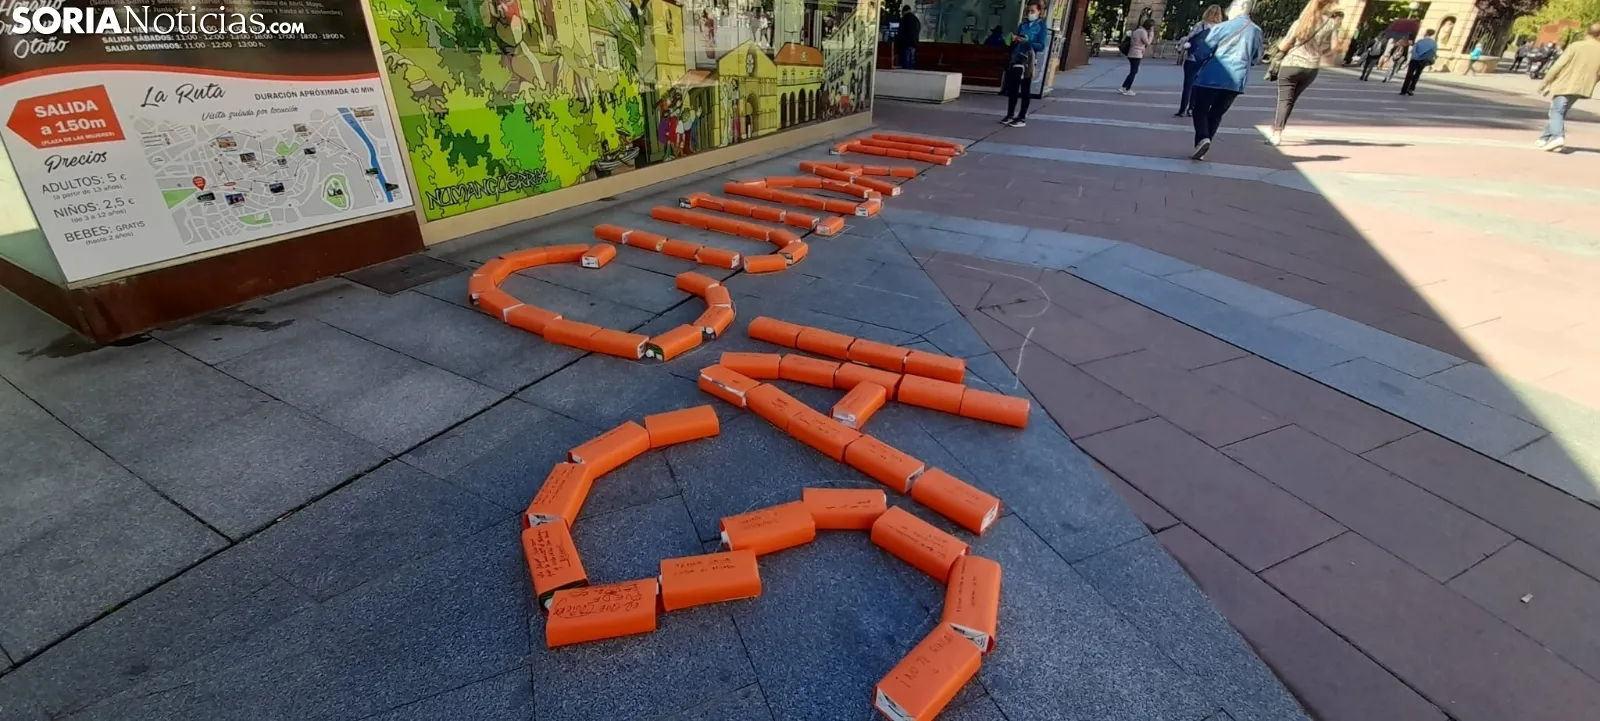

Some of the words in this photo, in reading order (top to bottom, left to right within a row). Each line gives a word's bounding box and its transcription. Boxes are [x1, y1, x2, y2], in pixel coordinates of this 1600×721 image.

[14, 36, 70, 58] Otoño
[136, 43, 183, 51] DOMINGOS:
[140, 86, 169, 107] La
[175, 82, 227, 104] Ruta
[254, 90, 298, 101] DURACIÓN
[361, 86, 375, 94] MIN
[34, 100, 99, 118] SALIDA
[201, 111, 227, 122] Visita
[228, 109, 254, 121] guiada
[255, 108, 269, 118] por
[40, 125, 52, 136] a
[55, 118, 107, 133] 150m
[44, 149, 108, 173] Precios
[42, 175, 105, 194] ADULTOS:
[106, 172, 117, 183] 5
[120, 173, 127, 181] €
[62, 190, 80, 199] partir
[53, 202, 101, 219] NIÑOS:
[102, 197, 125, 209] 2,5
[128, 197, 135, 205] €
[64, 225, 113, 243] BEBES:
[115, 220, 146, 232] GRATIS
